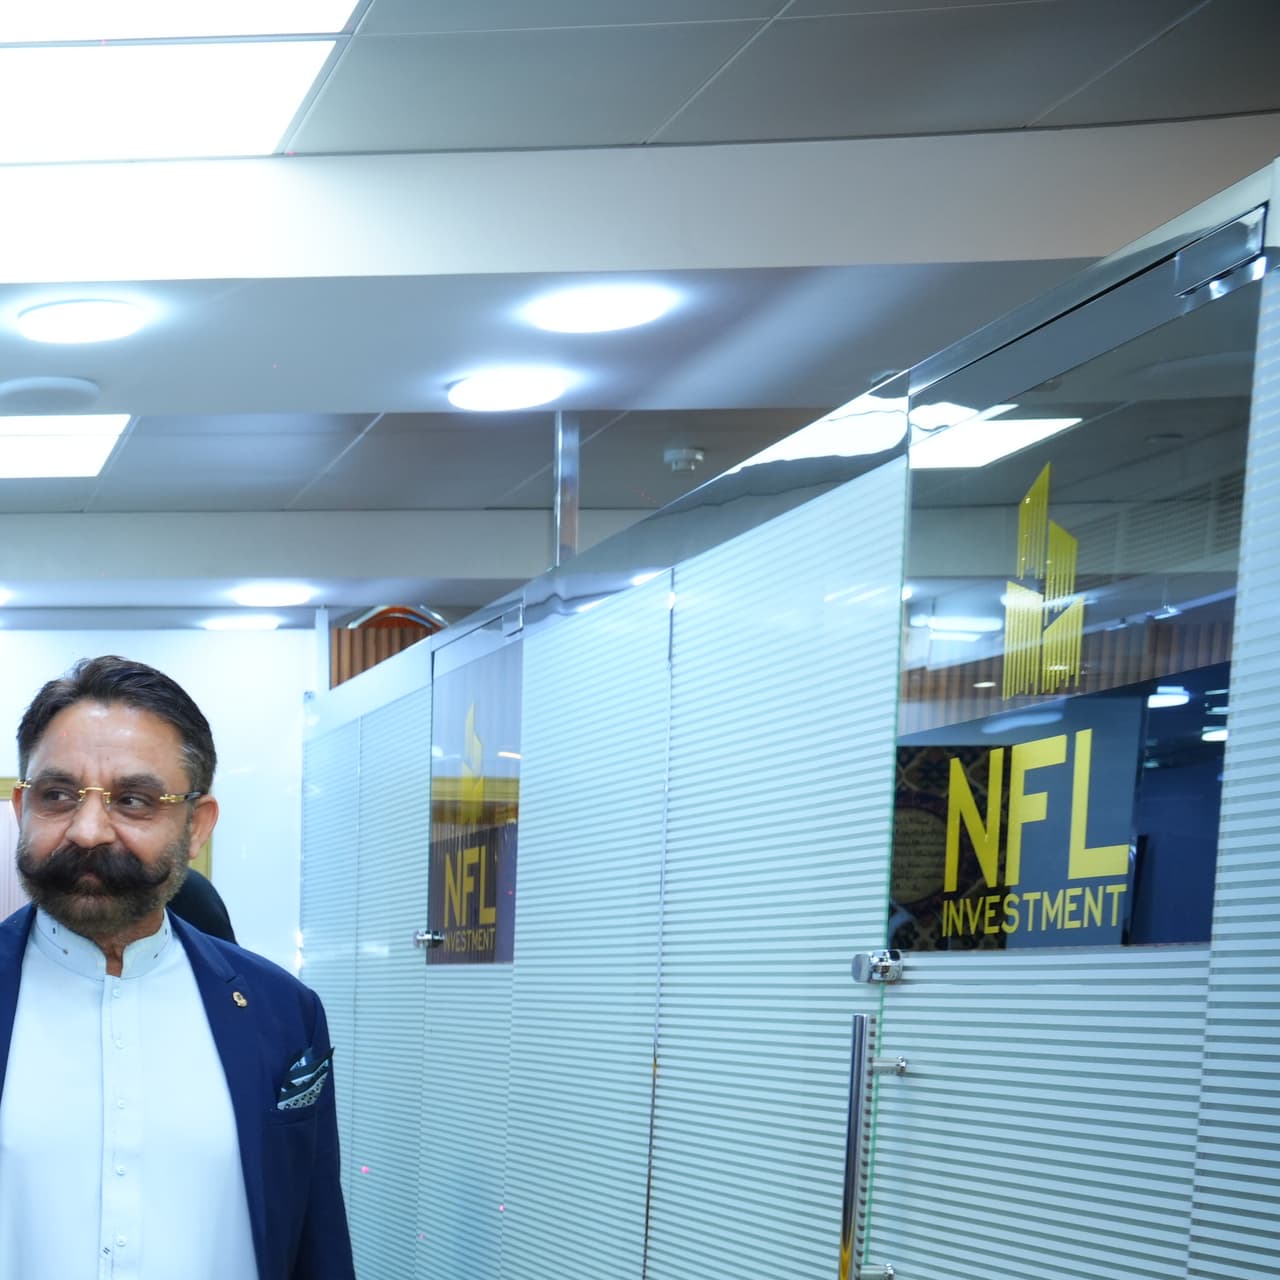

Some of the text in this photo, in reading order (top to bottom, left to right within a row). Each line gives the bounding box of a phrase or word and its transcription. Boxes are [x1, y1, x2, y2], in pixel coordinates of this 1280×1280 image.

[944, 728, 1130, 893] NFL
[444, 846, 497, 929] NFL
[942, 884, 1128, 938] INVESTMENT
